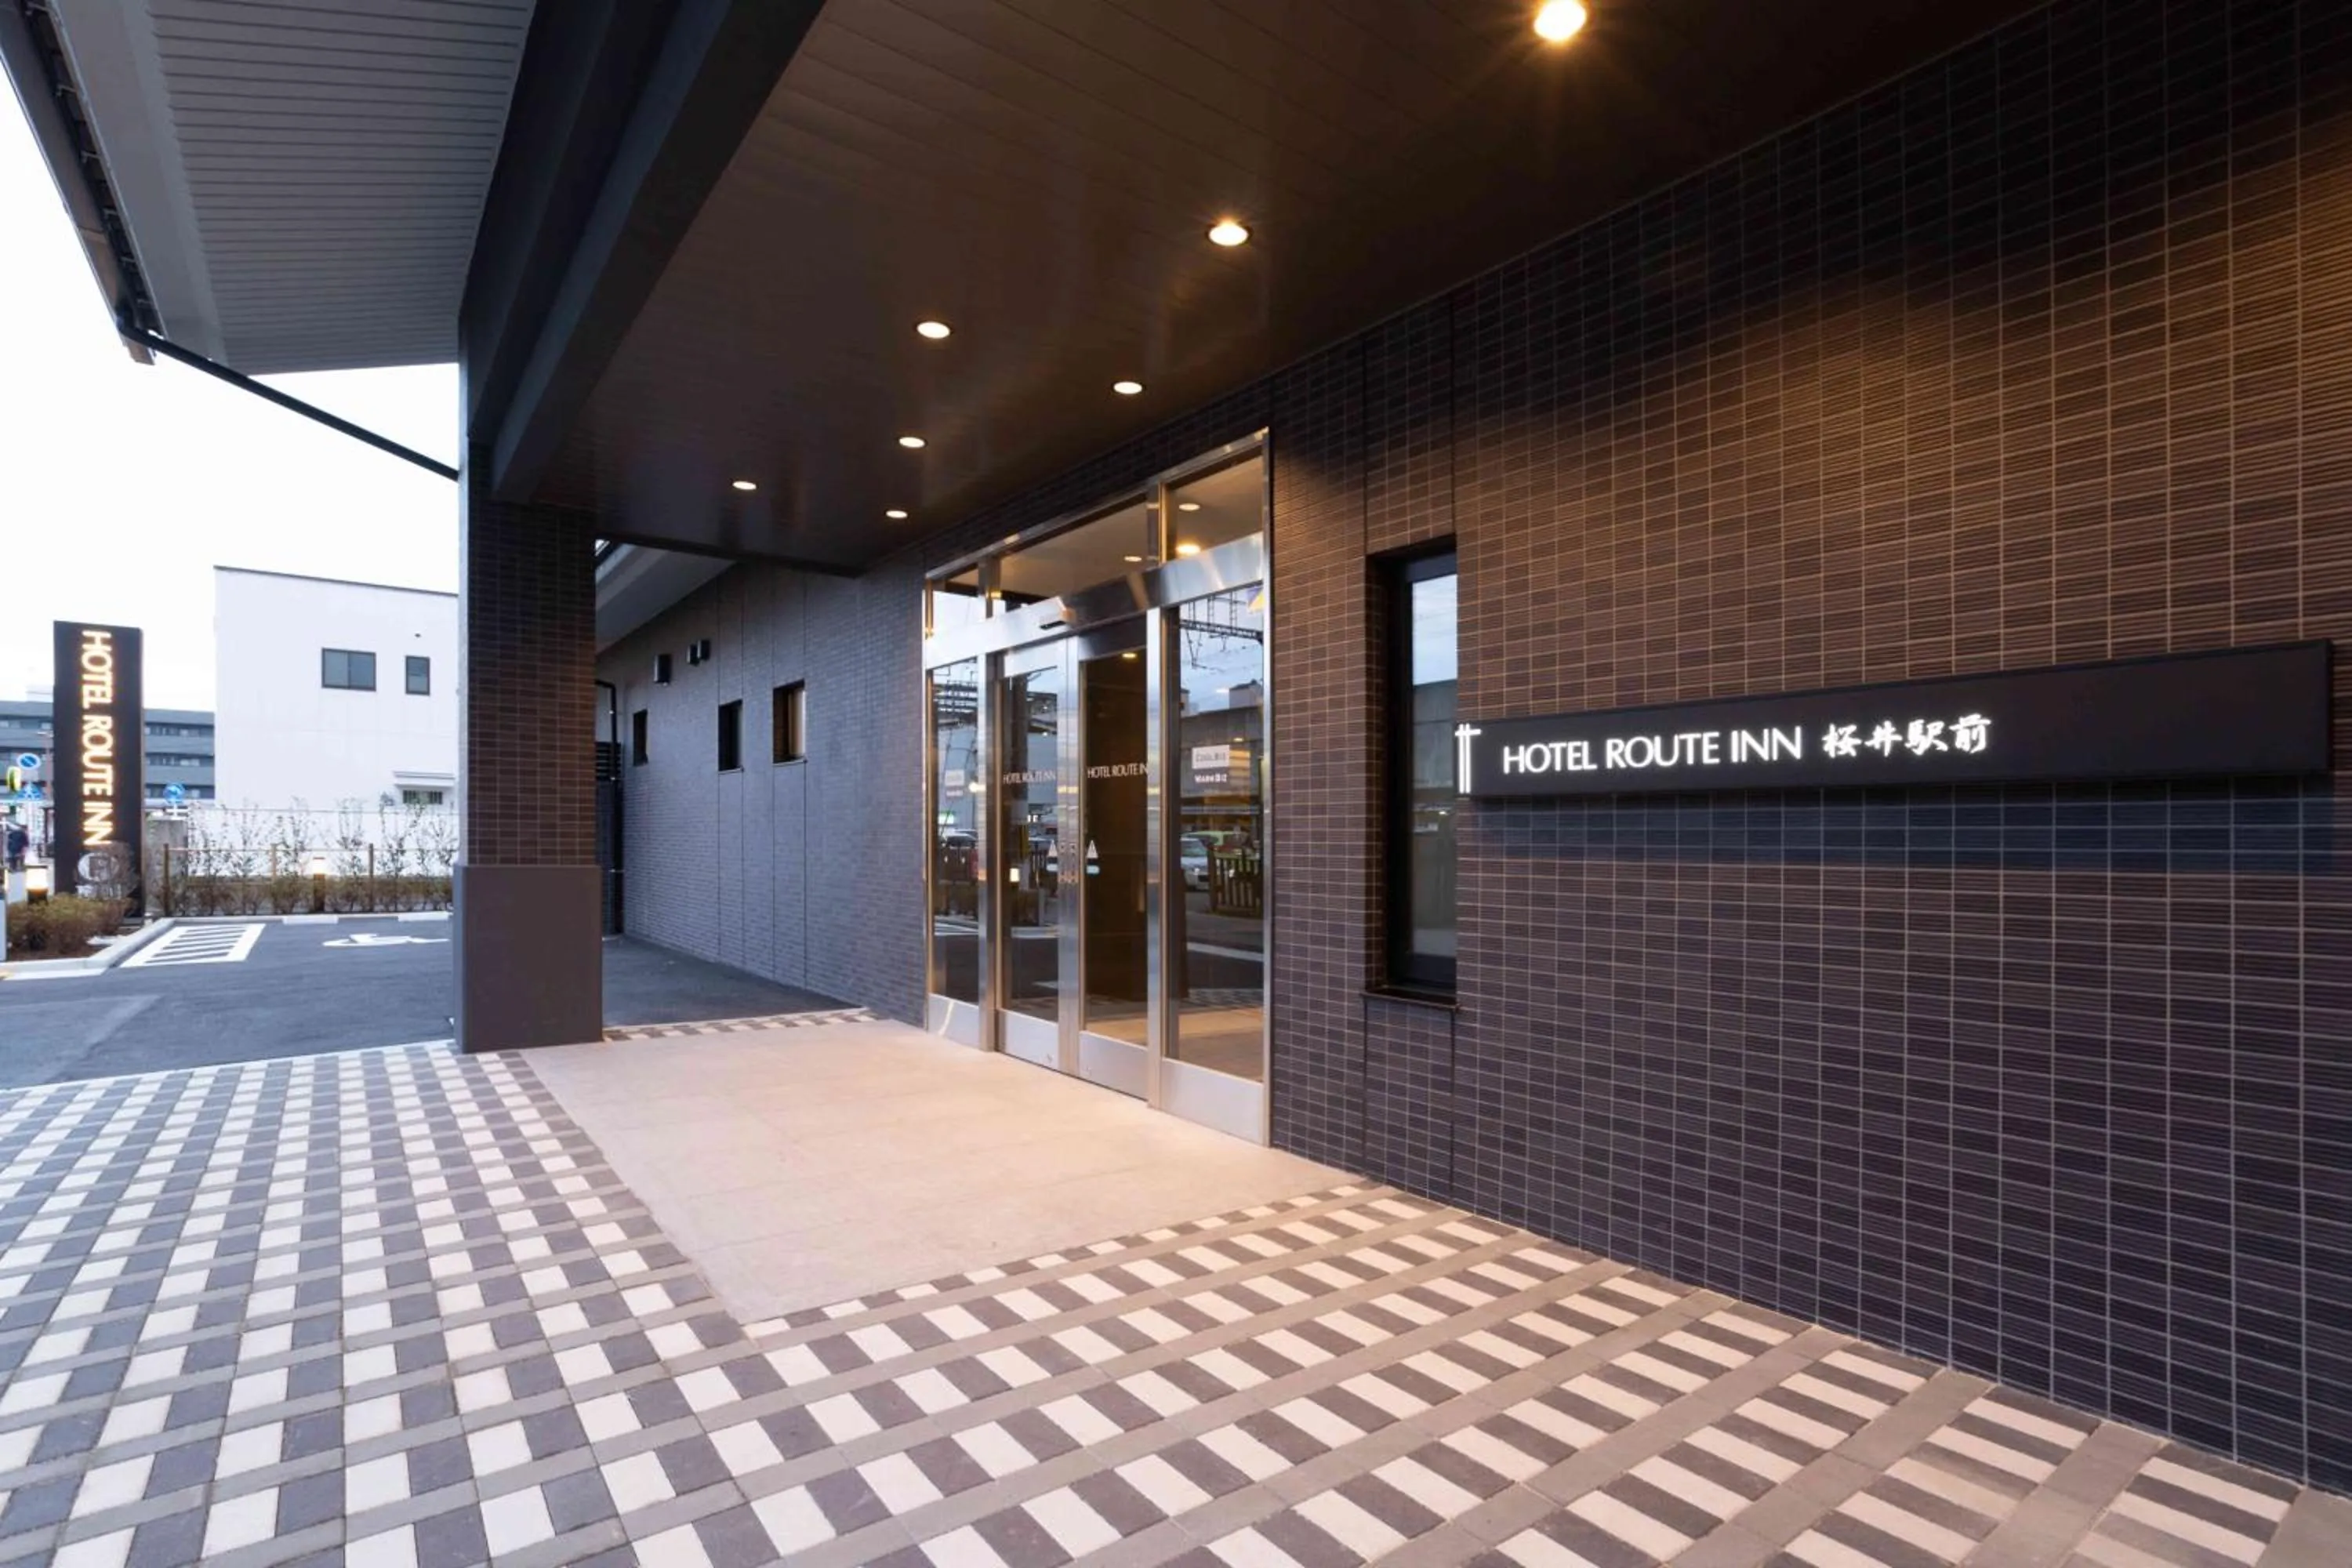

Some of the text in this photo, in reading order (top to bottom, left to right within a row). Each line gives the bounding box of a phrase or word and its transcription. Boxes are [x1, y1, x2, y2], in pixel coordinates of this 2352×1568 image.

[80, 630, 114, 710] HOTEL
[81, 714, 114, 797] ROUTE
[1087, 765, 1110, 779] HOTEL
[1112, 763, 1138, 777] ROUTE
[1502, 713, 1992, 775] HOTEL ROUTE INN 桜井駅前
[82, 801, 114, 846] INN
